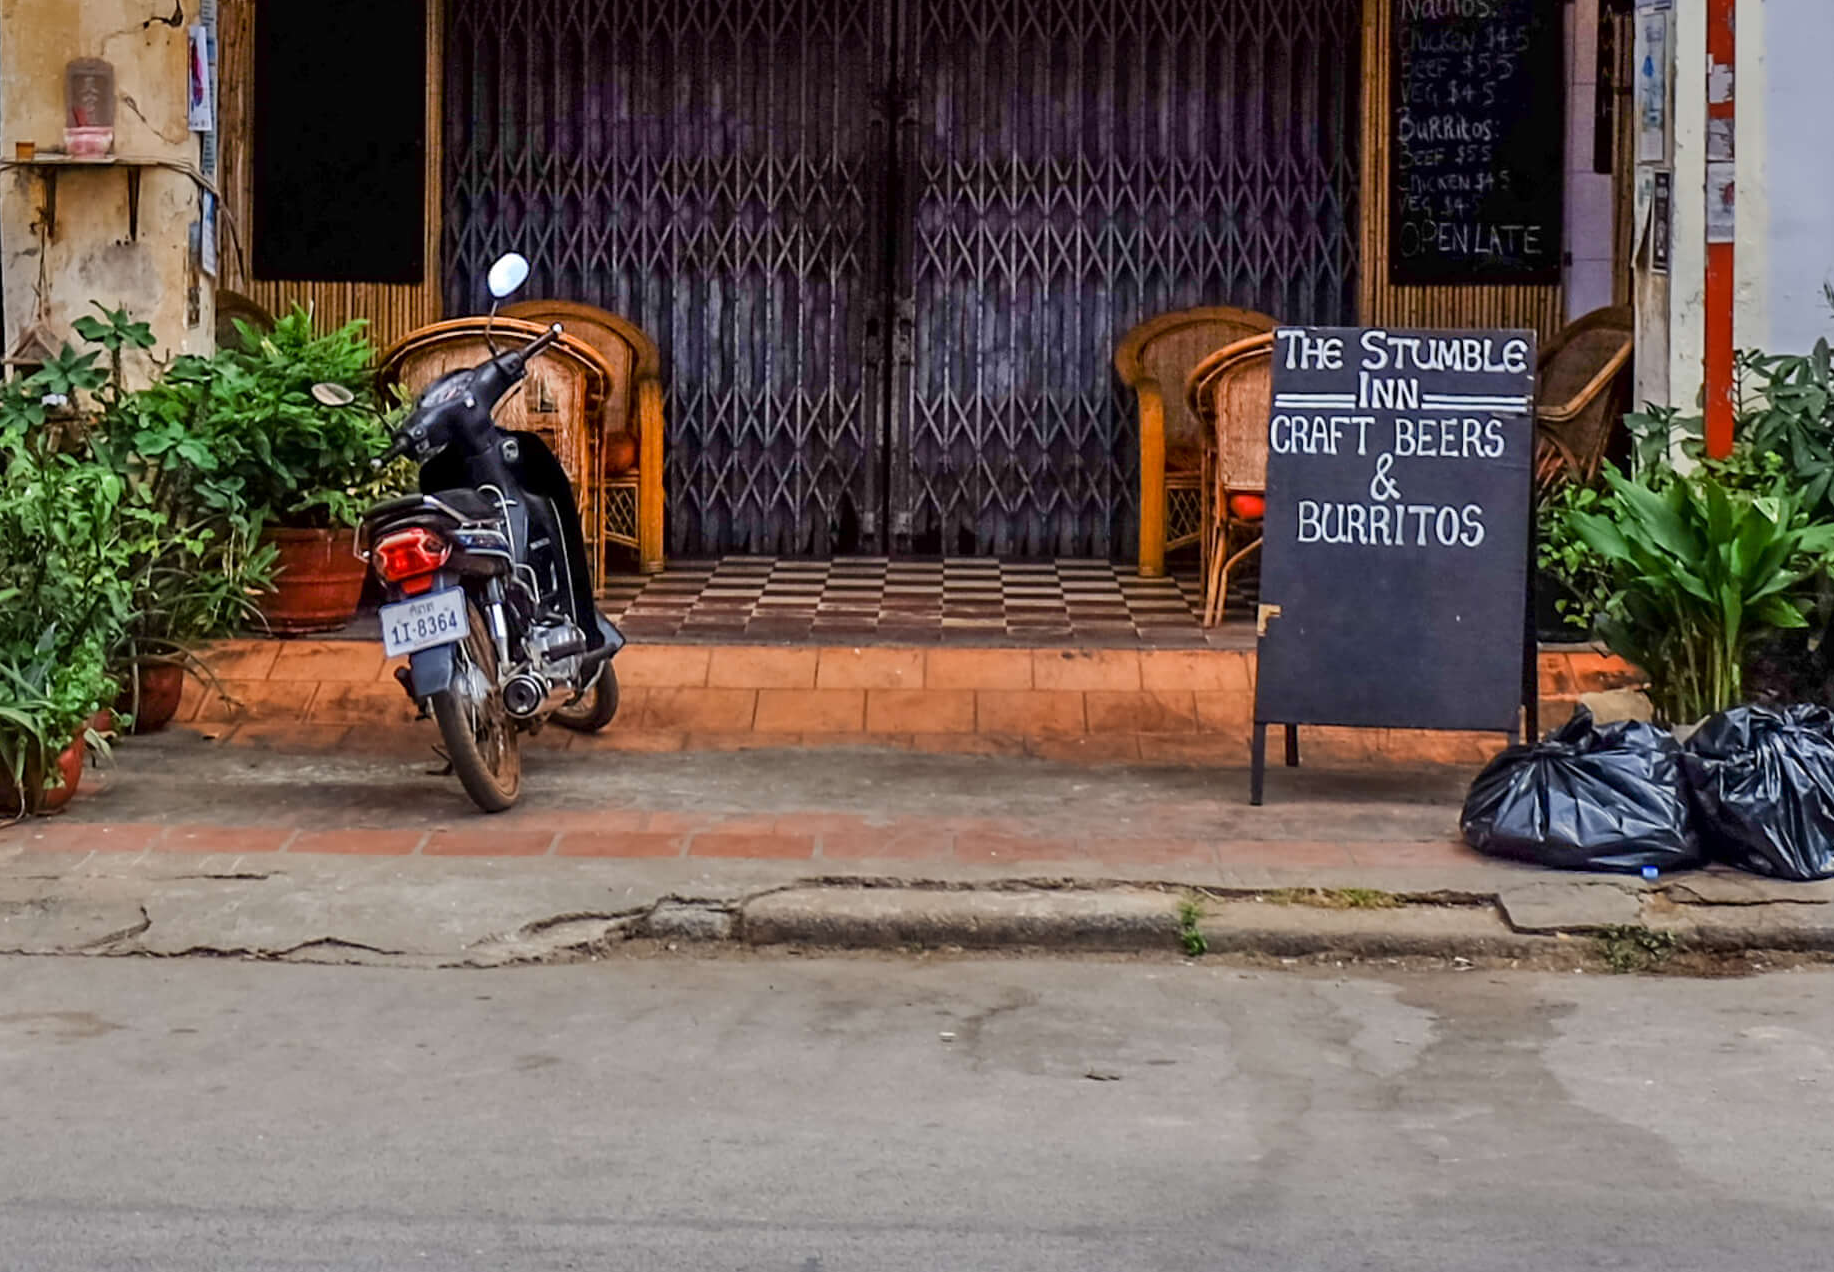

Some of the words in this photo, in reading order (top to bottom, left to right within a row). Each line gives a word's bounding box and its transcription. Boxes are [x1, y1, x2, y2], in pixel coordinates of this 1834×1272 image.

[1400, 219, 1470, 259] OPEN
[1473, 222, 1544, 257] LATE
[1278, 328, 1344, 372] THE
[1360, 329, 1529, 373] STUMBLE
[1358, 371, 1420, 410] INN
[1270, 415, 1375, 456] CRAFT
[1394, 418, 1505, 458] BEERS
[1369, 452, 1402, 502] &
[1297, 501, 1486, 549] BURRITOS
